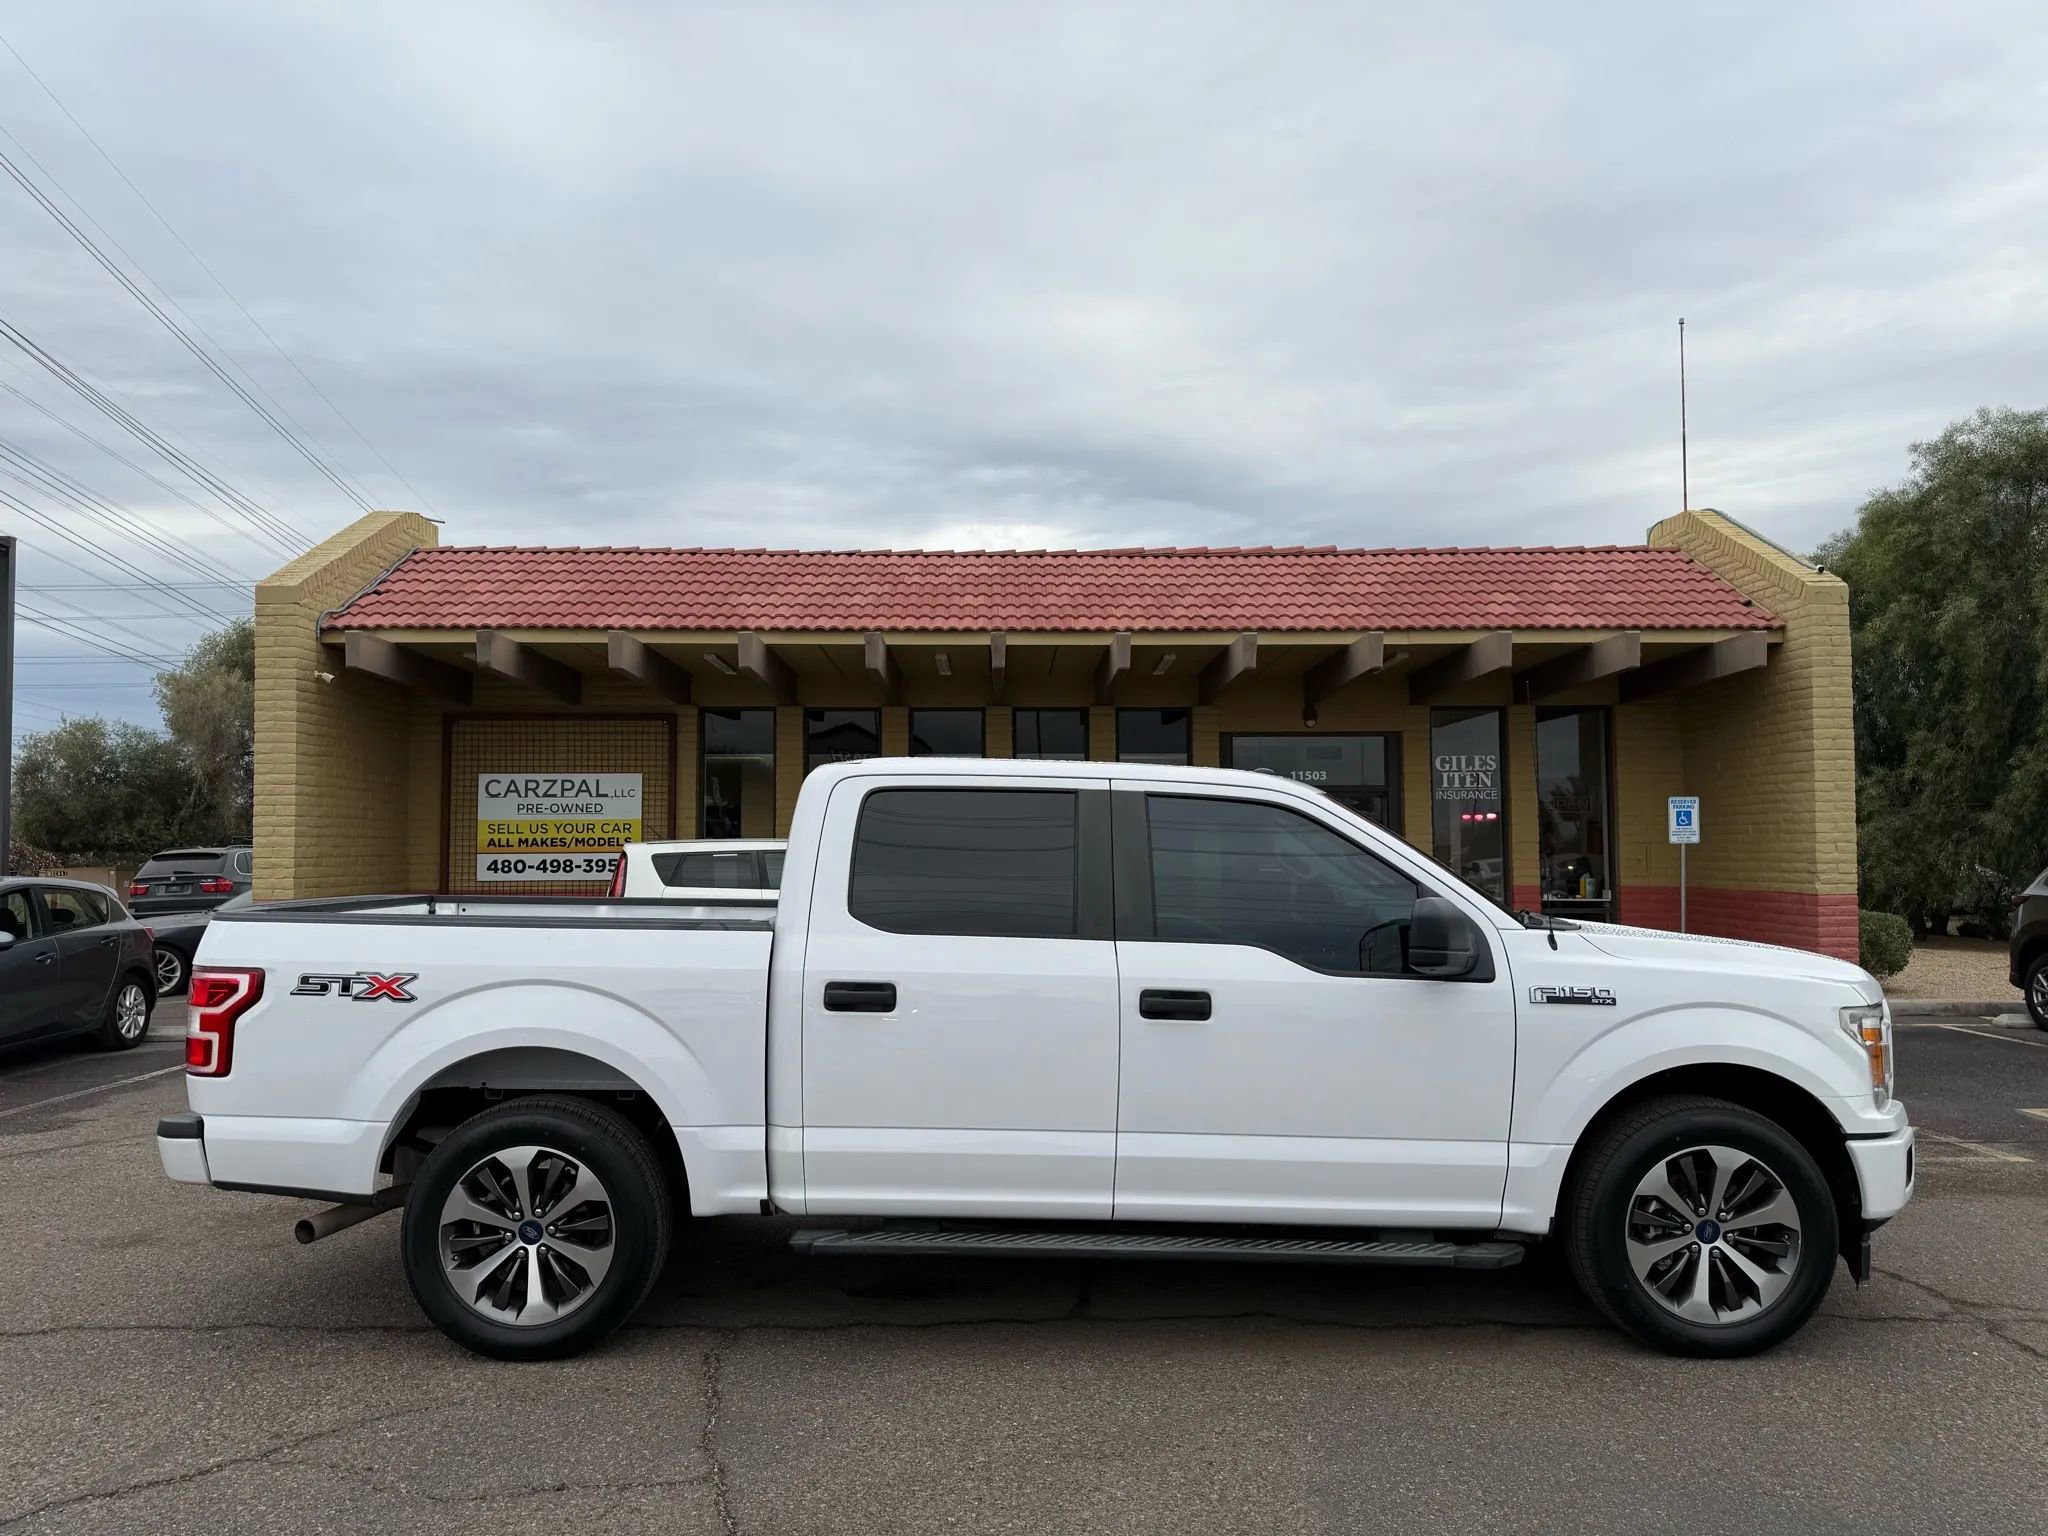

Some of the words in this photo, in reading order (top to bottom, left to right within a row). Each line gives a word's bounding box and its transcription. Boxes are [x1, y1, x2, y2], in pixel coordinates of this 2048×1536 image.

[1435, 755, 1496, 771] GILES
[1290, 771, 1327, 781] 11503
[1441, 772, 1493, 787] ITEN
[484, 779, 609, 798] CARZPAL
[1436, 790, 1498, 800] INSURANCE
[517, 803, 604, 813] PRE-OWNED
[487, 823, 524, 834] SELL
[529, 823, 549, 834] US
[554, 823, 596, 834] YOUR
[600, 823, 632, 833] CAR
[487, 837, 514, 848] ALL
[486, 858, 618, 874] 480-498-395
[289, 971, 420, 1003] STX
